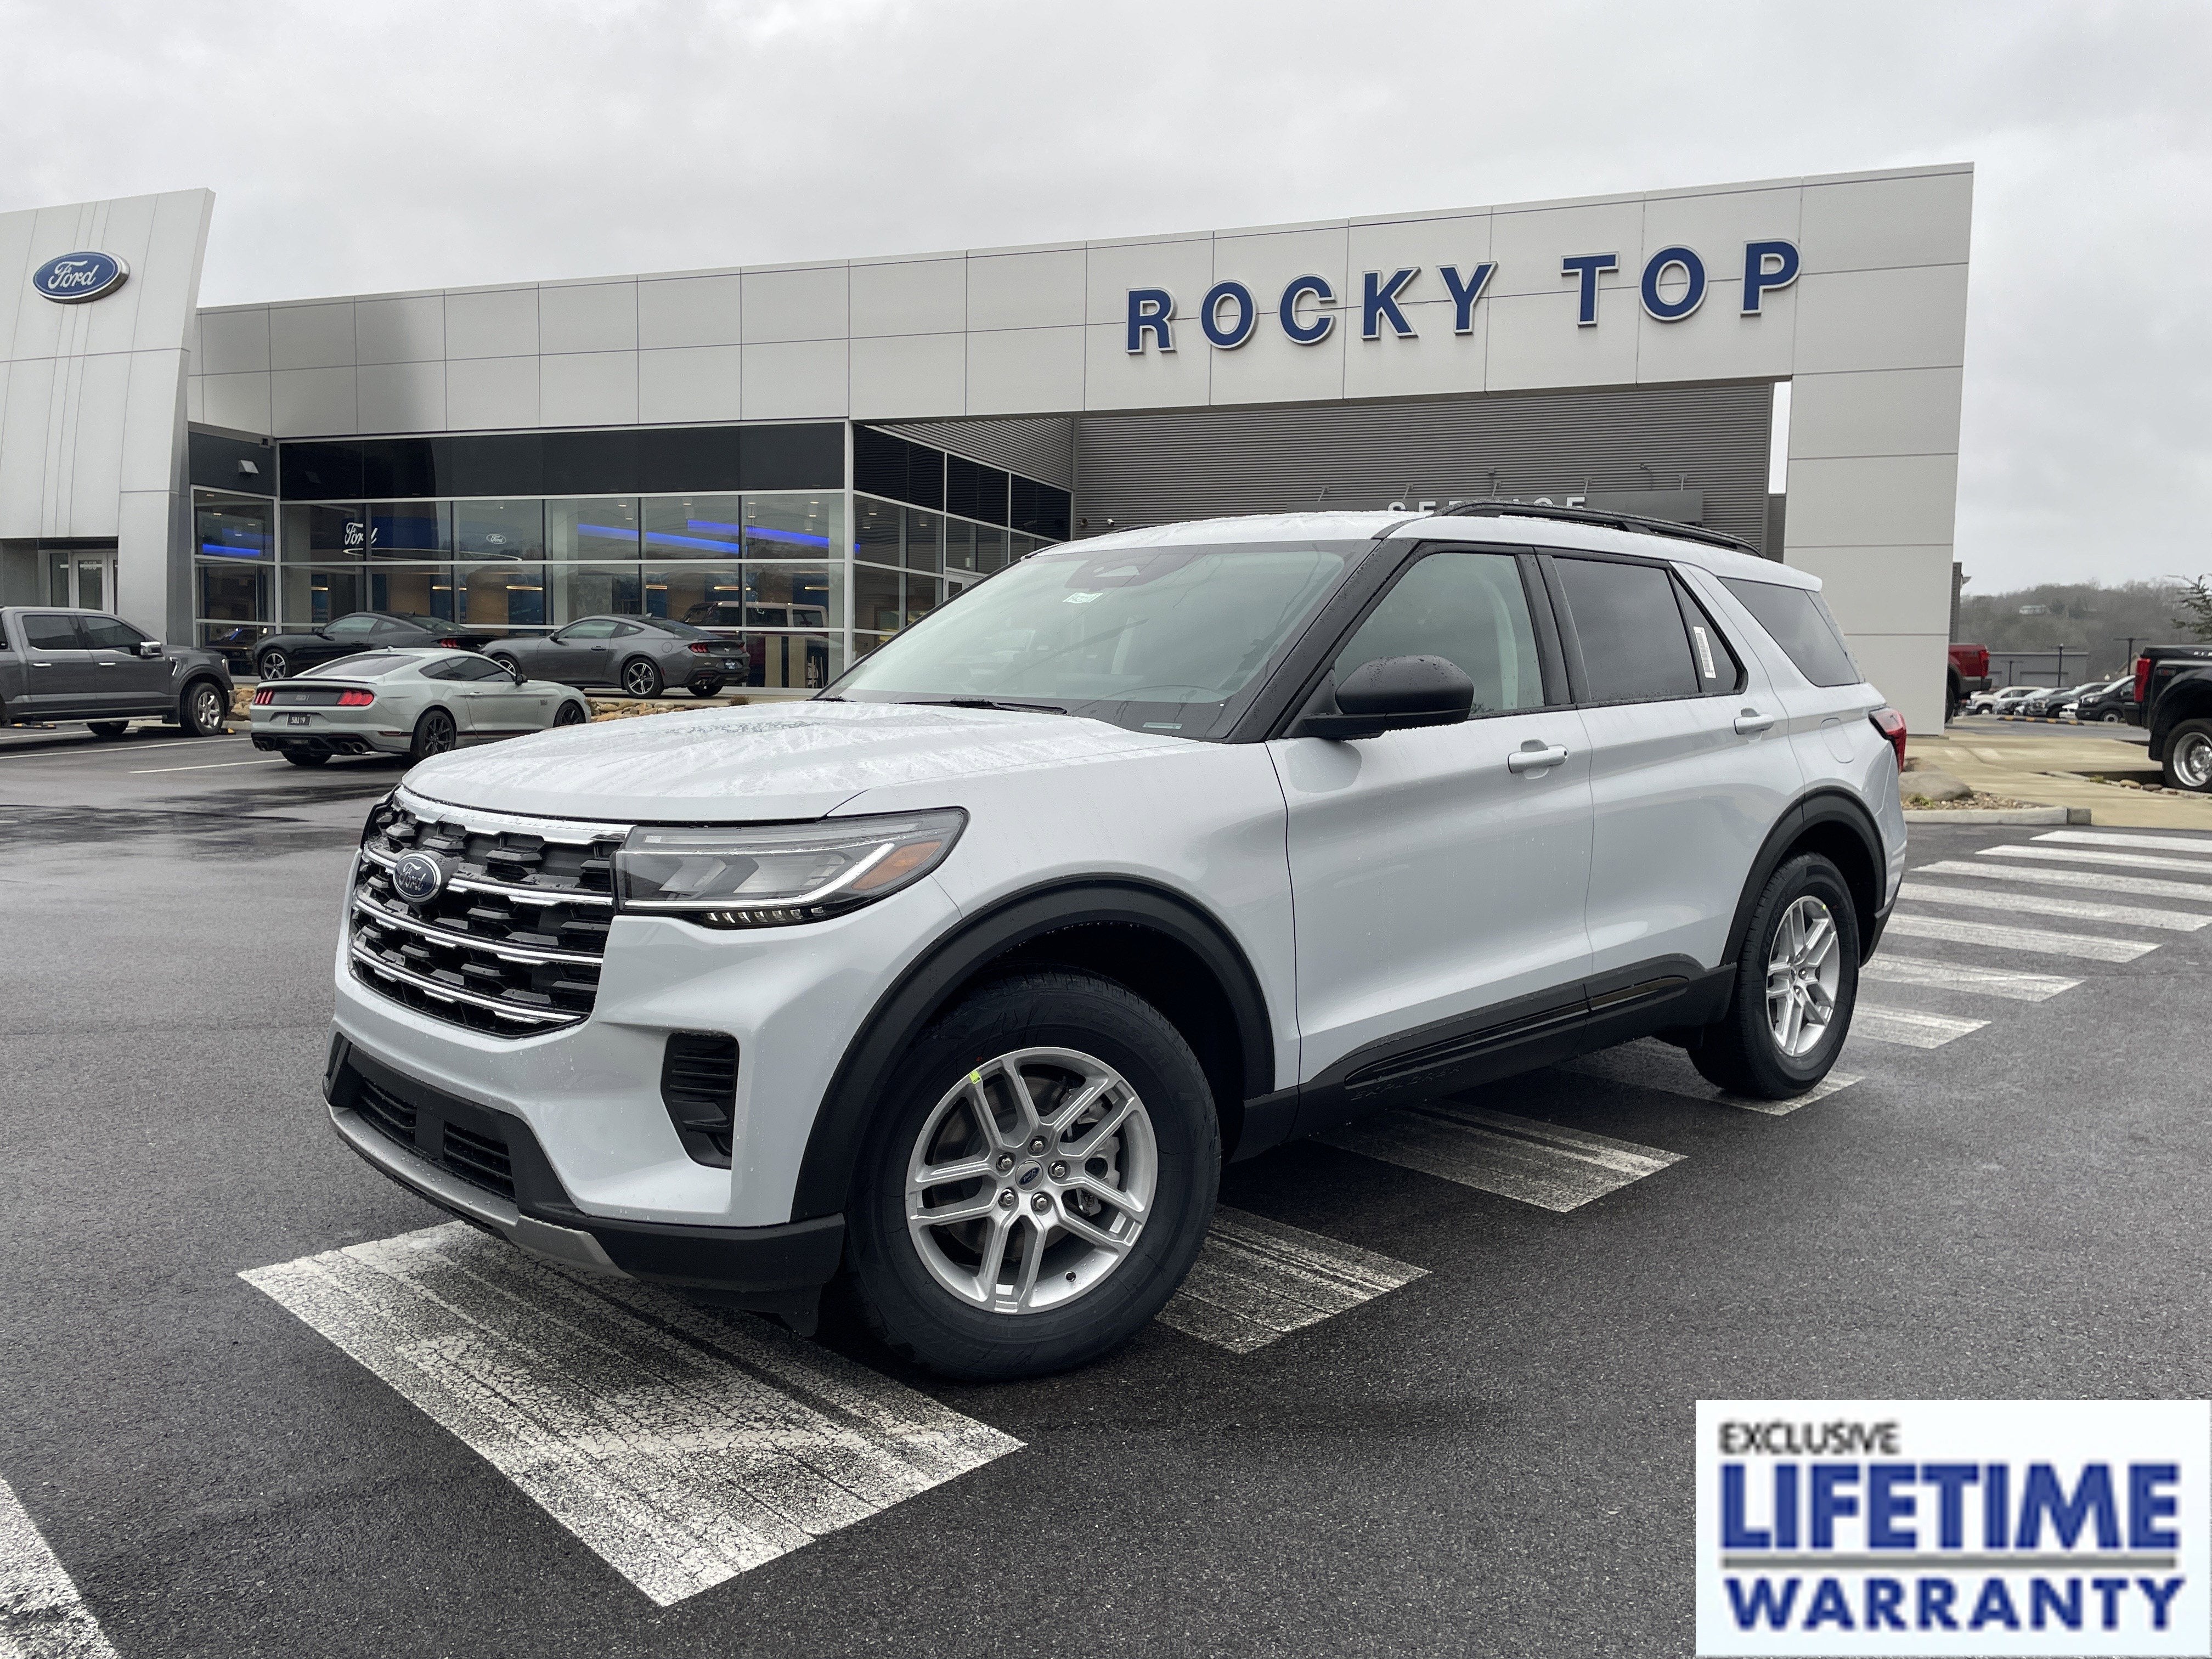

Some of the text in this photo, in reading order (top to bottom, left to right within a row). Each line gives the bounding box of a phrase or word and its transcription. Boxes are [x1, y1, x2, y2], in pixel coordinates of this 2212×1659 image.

[48, 261, 99, 289] Ford
[1126, 240, 1800, 352] ROCKY TOP
[399, 862, 426, 891] Ford
